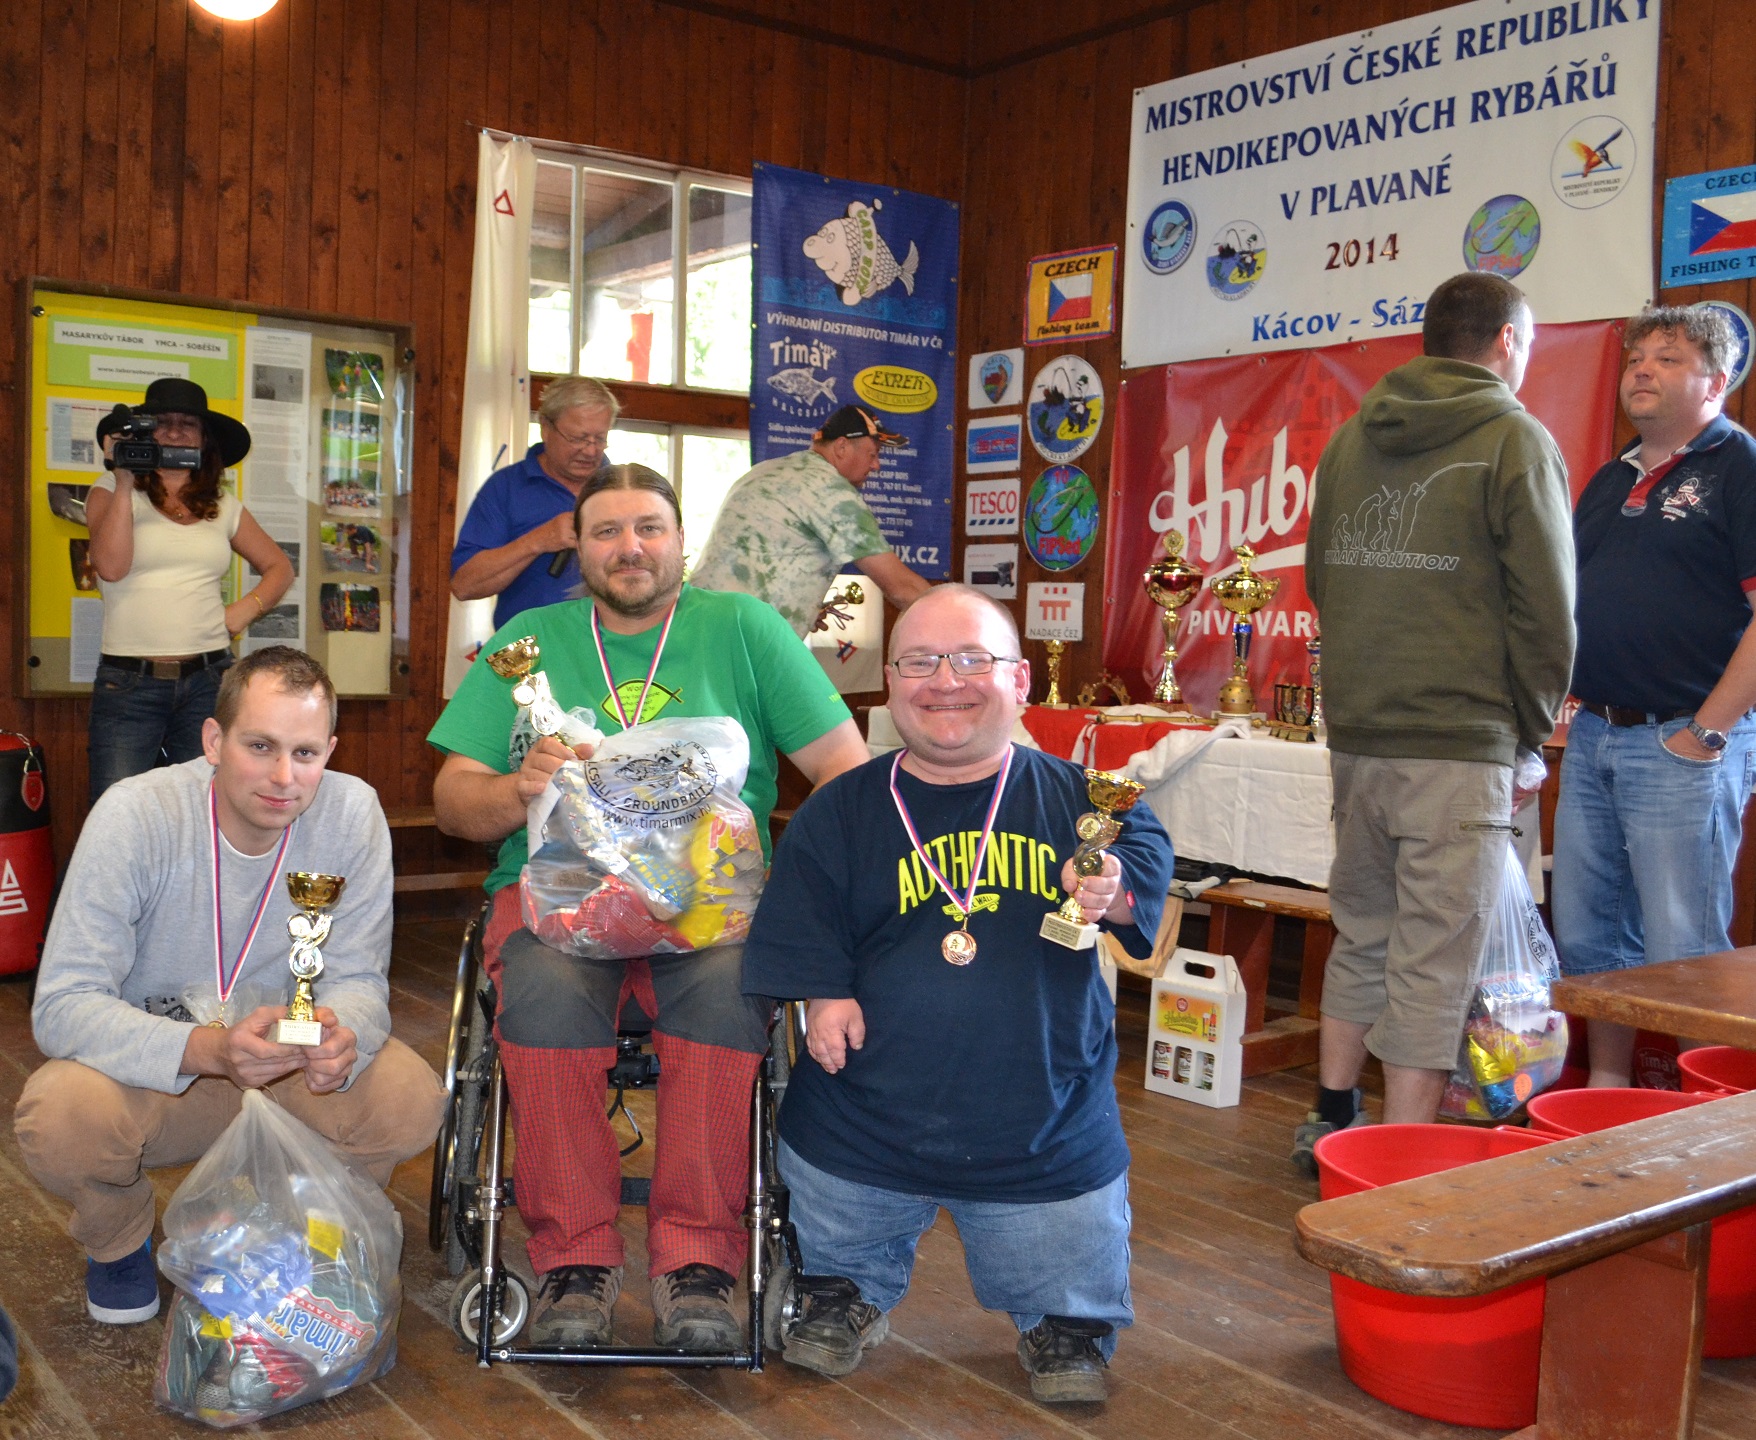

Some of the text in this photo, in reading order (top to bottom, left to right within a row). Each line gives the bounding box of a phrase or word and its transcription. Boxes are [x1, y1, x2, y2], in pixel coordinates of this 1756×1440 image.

[1145, 52, 1336, 134] MISTROVSTVÍ
[1343, 26, 1442, 86] ČESKÉ
[1162, 53, 1618, 185] HENDIKEPOVANÝCH RYBÁŘŮ
[1280, 153, 1453, 221] V PLAVANÉ
[1705, 171, 1756, 190] CZEC
[1324, 233, 1400, 271] 2014
[1044, 256, 1101, 277] CZECH
[1670, 258, 1741, 278] FISHING
[767, 312, 943, 349] VÝHRADNÍ DISTRIBUTOR TIMÁR V ČR
[1037, 321, 1099, 337] fishing team
[1252, 311, 1341, 342] Kácov
[1371, 296, 1426, 328] Sáz
[62, 330, 113, 341] MASARYKŮV
[117, 335, 144, 344] TÁBOR
[154, 339, 177, 348] YMCA
[186, 342, 221, 352] SOBĚŠÍN
[769, 336, 833, 371] Timár
[969, 491, 1017, 514] TESCO
[890, 545, 939, 565] IX.CZ
[1038, 536, 1081, 555] FIPSed
[1360, 552, 1459, 570] EVOLUTION
[1030, 626, 1078, 638] NADACE ČEZ
[1188, 610, 1312, 638] PIVVAR
[623, 786, 706, 811] GROUNDBAIT
[898, 831, 1057, 914] AUTHENTIC
[977, 895, 993, 905] WALL
